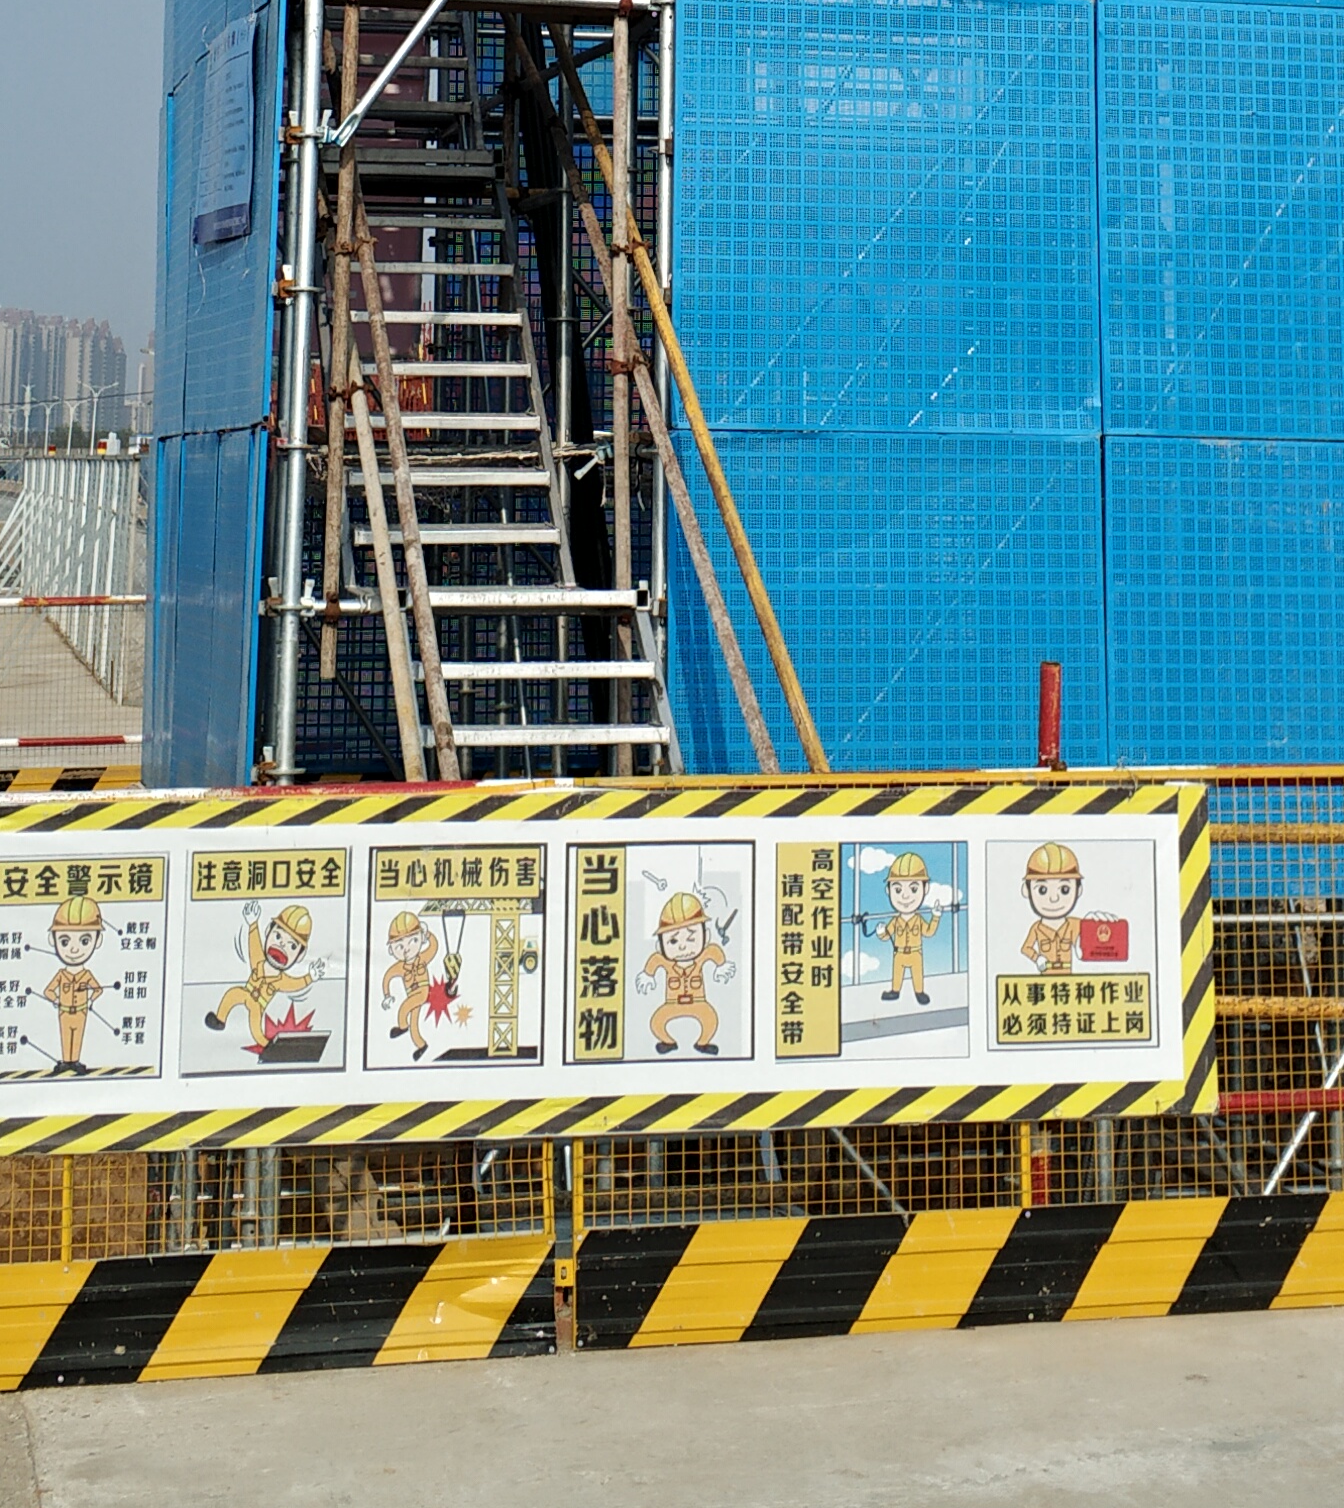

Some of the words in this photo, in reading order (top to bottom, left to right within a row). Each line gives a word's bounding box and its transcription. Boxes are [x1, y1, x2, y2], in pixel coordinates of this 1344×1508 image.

[2, 862, 154, 899] 安全警示镜
[196, 855, 342, 892] 注意洞口安全
[378, 854, 538, 889] 当心机械伤害
[125, 921, 150, 935] 戴好
[810, 846, 835, 989] 高空作业时
[120, 937, 157, 951] 安全帽
[579, 853, 621, 1053] 当心落物
[780, 873, 805, 1045] 请配带安全带
[124, 970, 148, 984] 扣好
[123, 986, 147, 1000] 纽扣
[1001, 979, 1145, 1007] 从事特种作业
[121, 1015, 146, 1029] 戴好
[1001, 1010, 1146, 1037] 必须持证上岗
[121, 1031, 145, 1045] 手套
